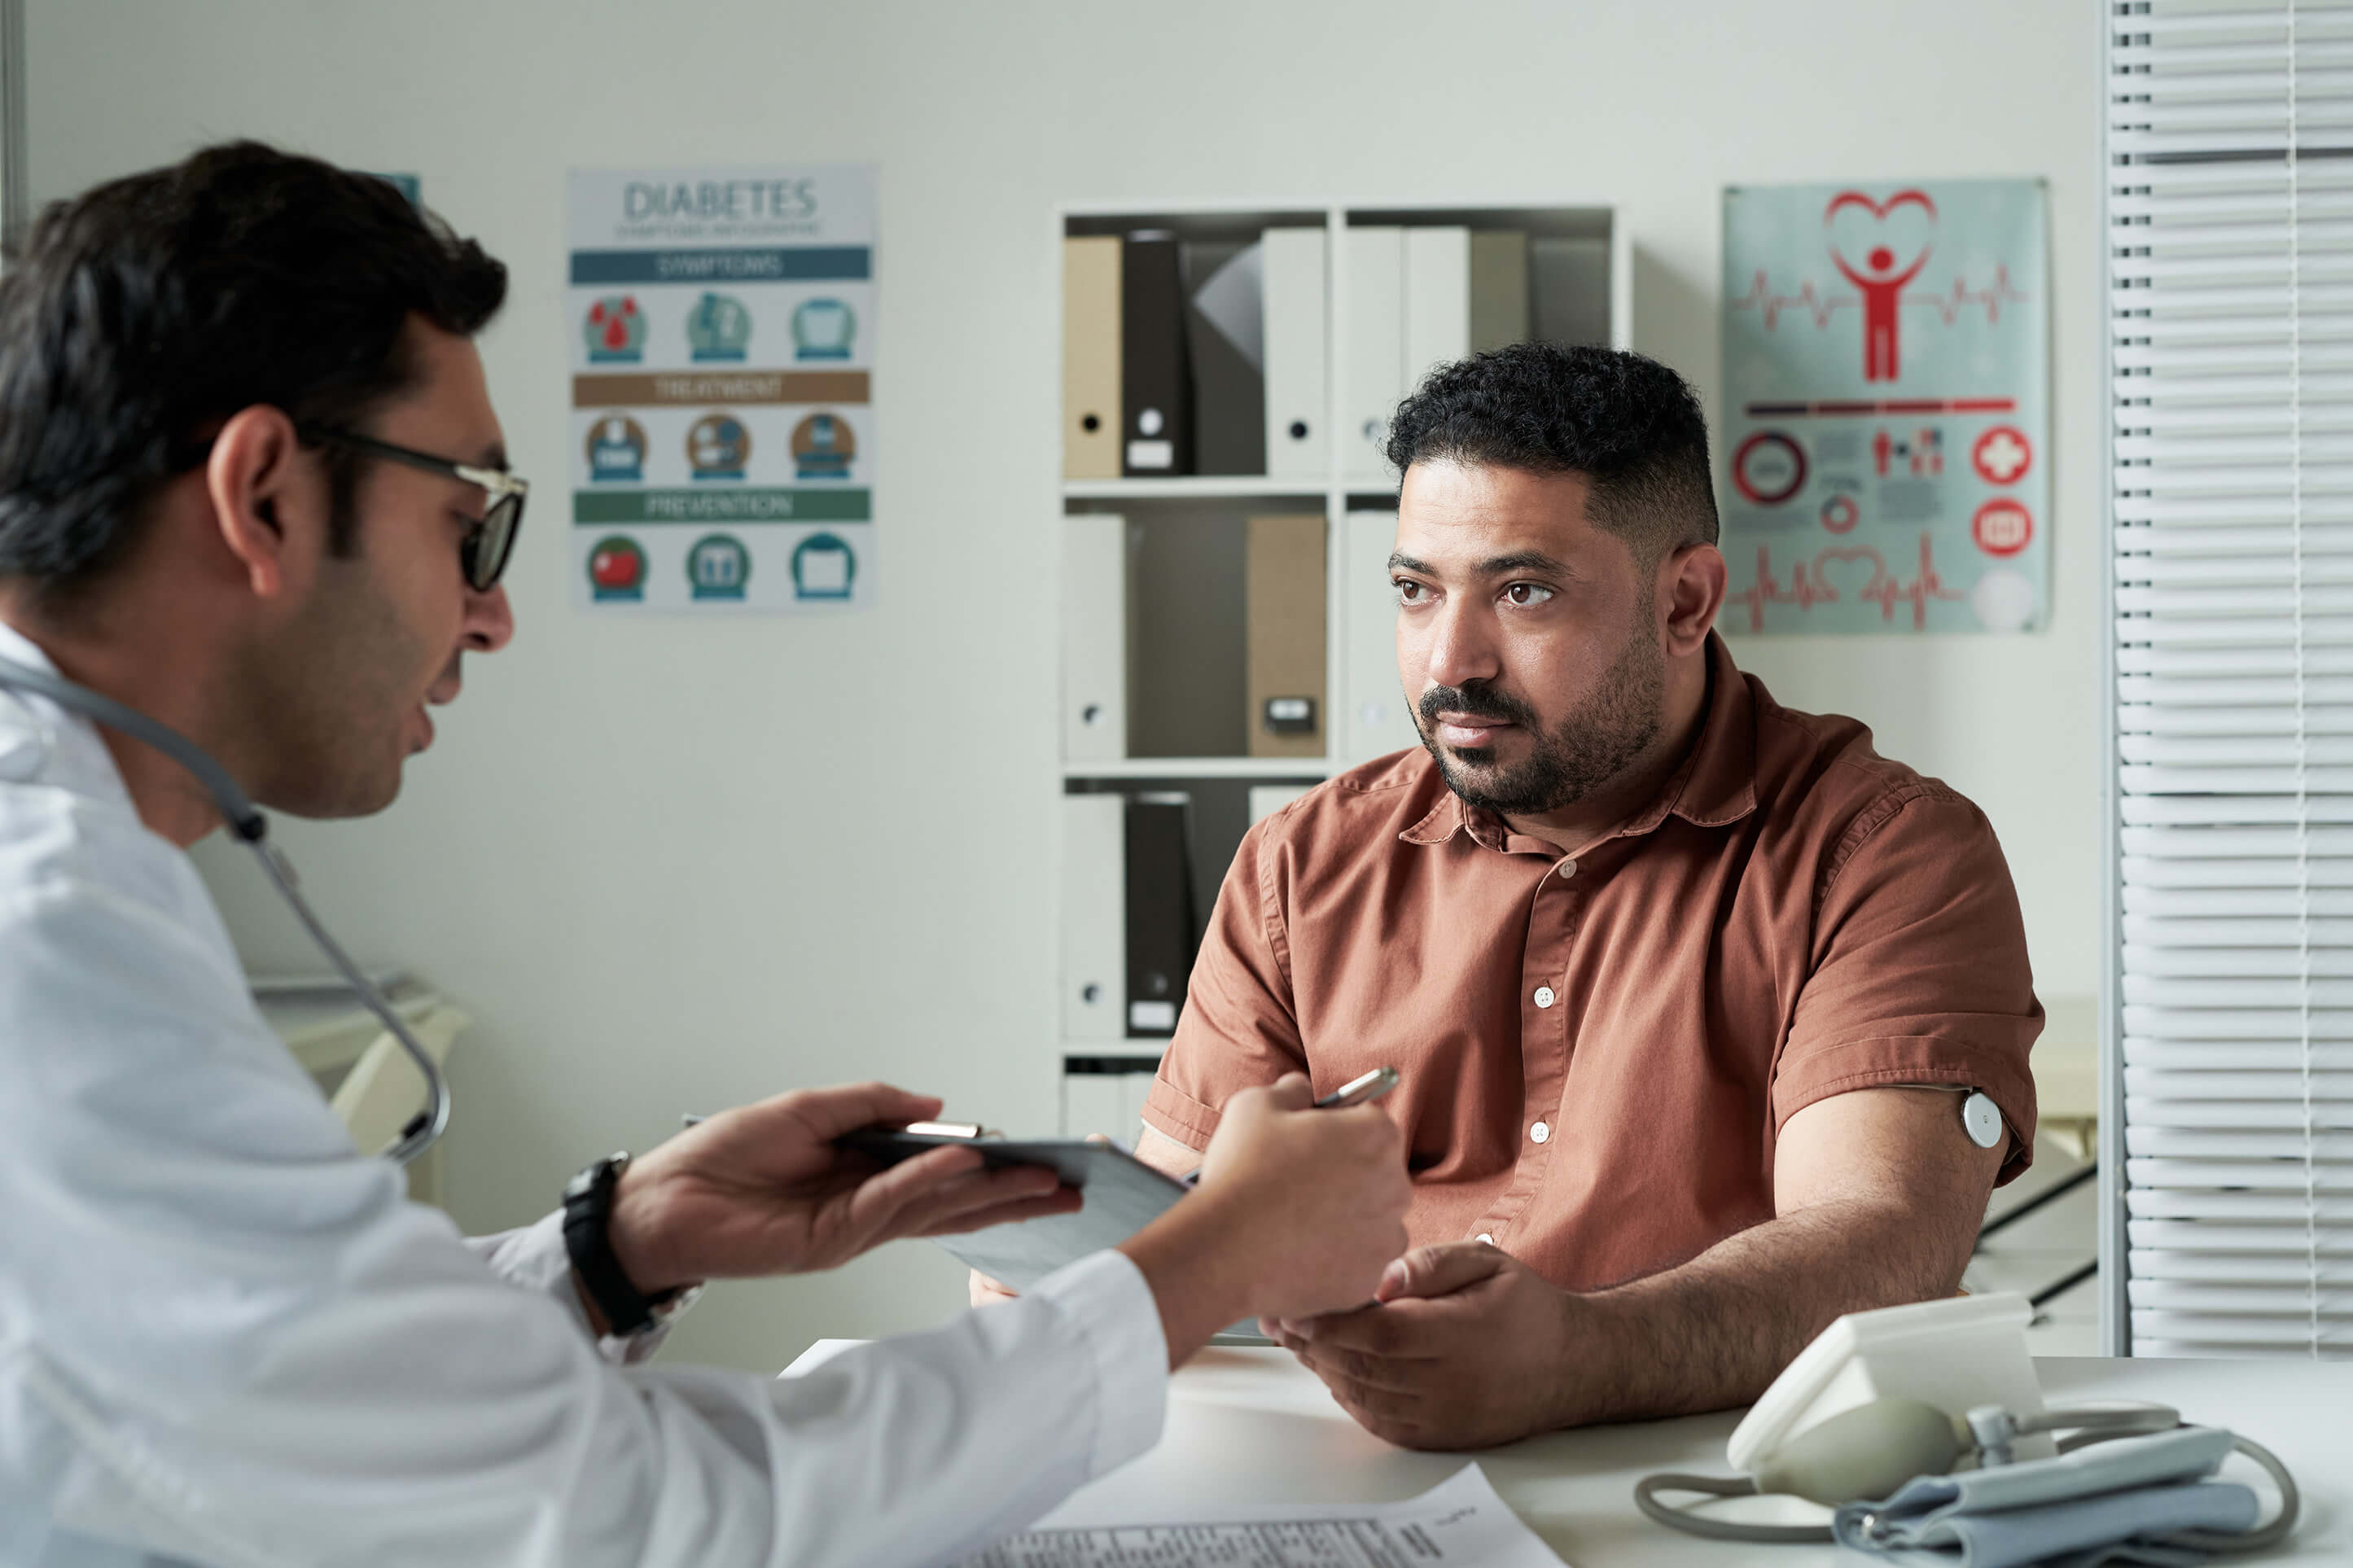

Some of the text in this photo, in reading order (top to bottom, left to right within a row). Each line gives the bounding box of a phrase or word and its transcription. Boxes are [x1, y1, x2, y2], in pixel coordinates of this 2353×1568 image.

[624, 179, 818, 221] DIABETES
[657, 255, 782, 276] SYMPTOMS
[656, 377, 782, 398] TREATMENT
[646, 494, 792, 515] PREVENTION
